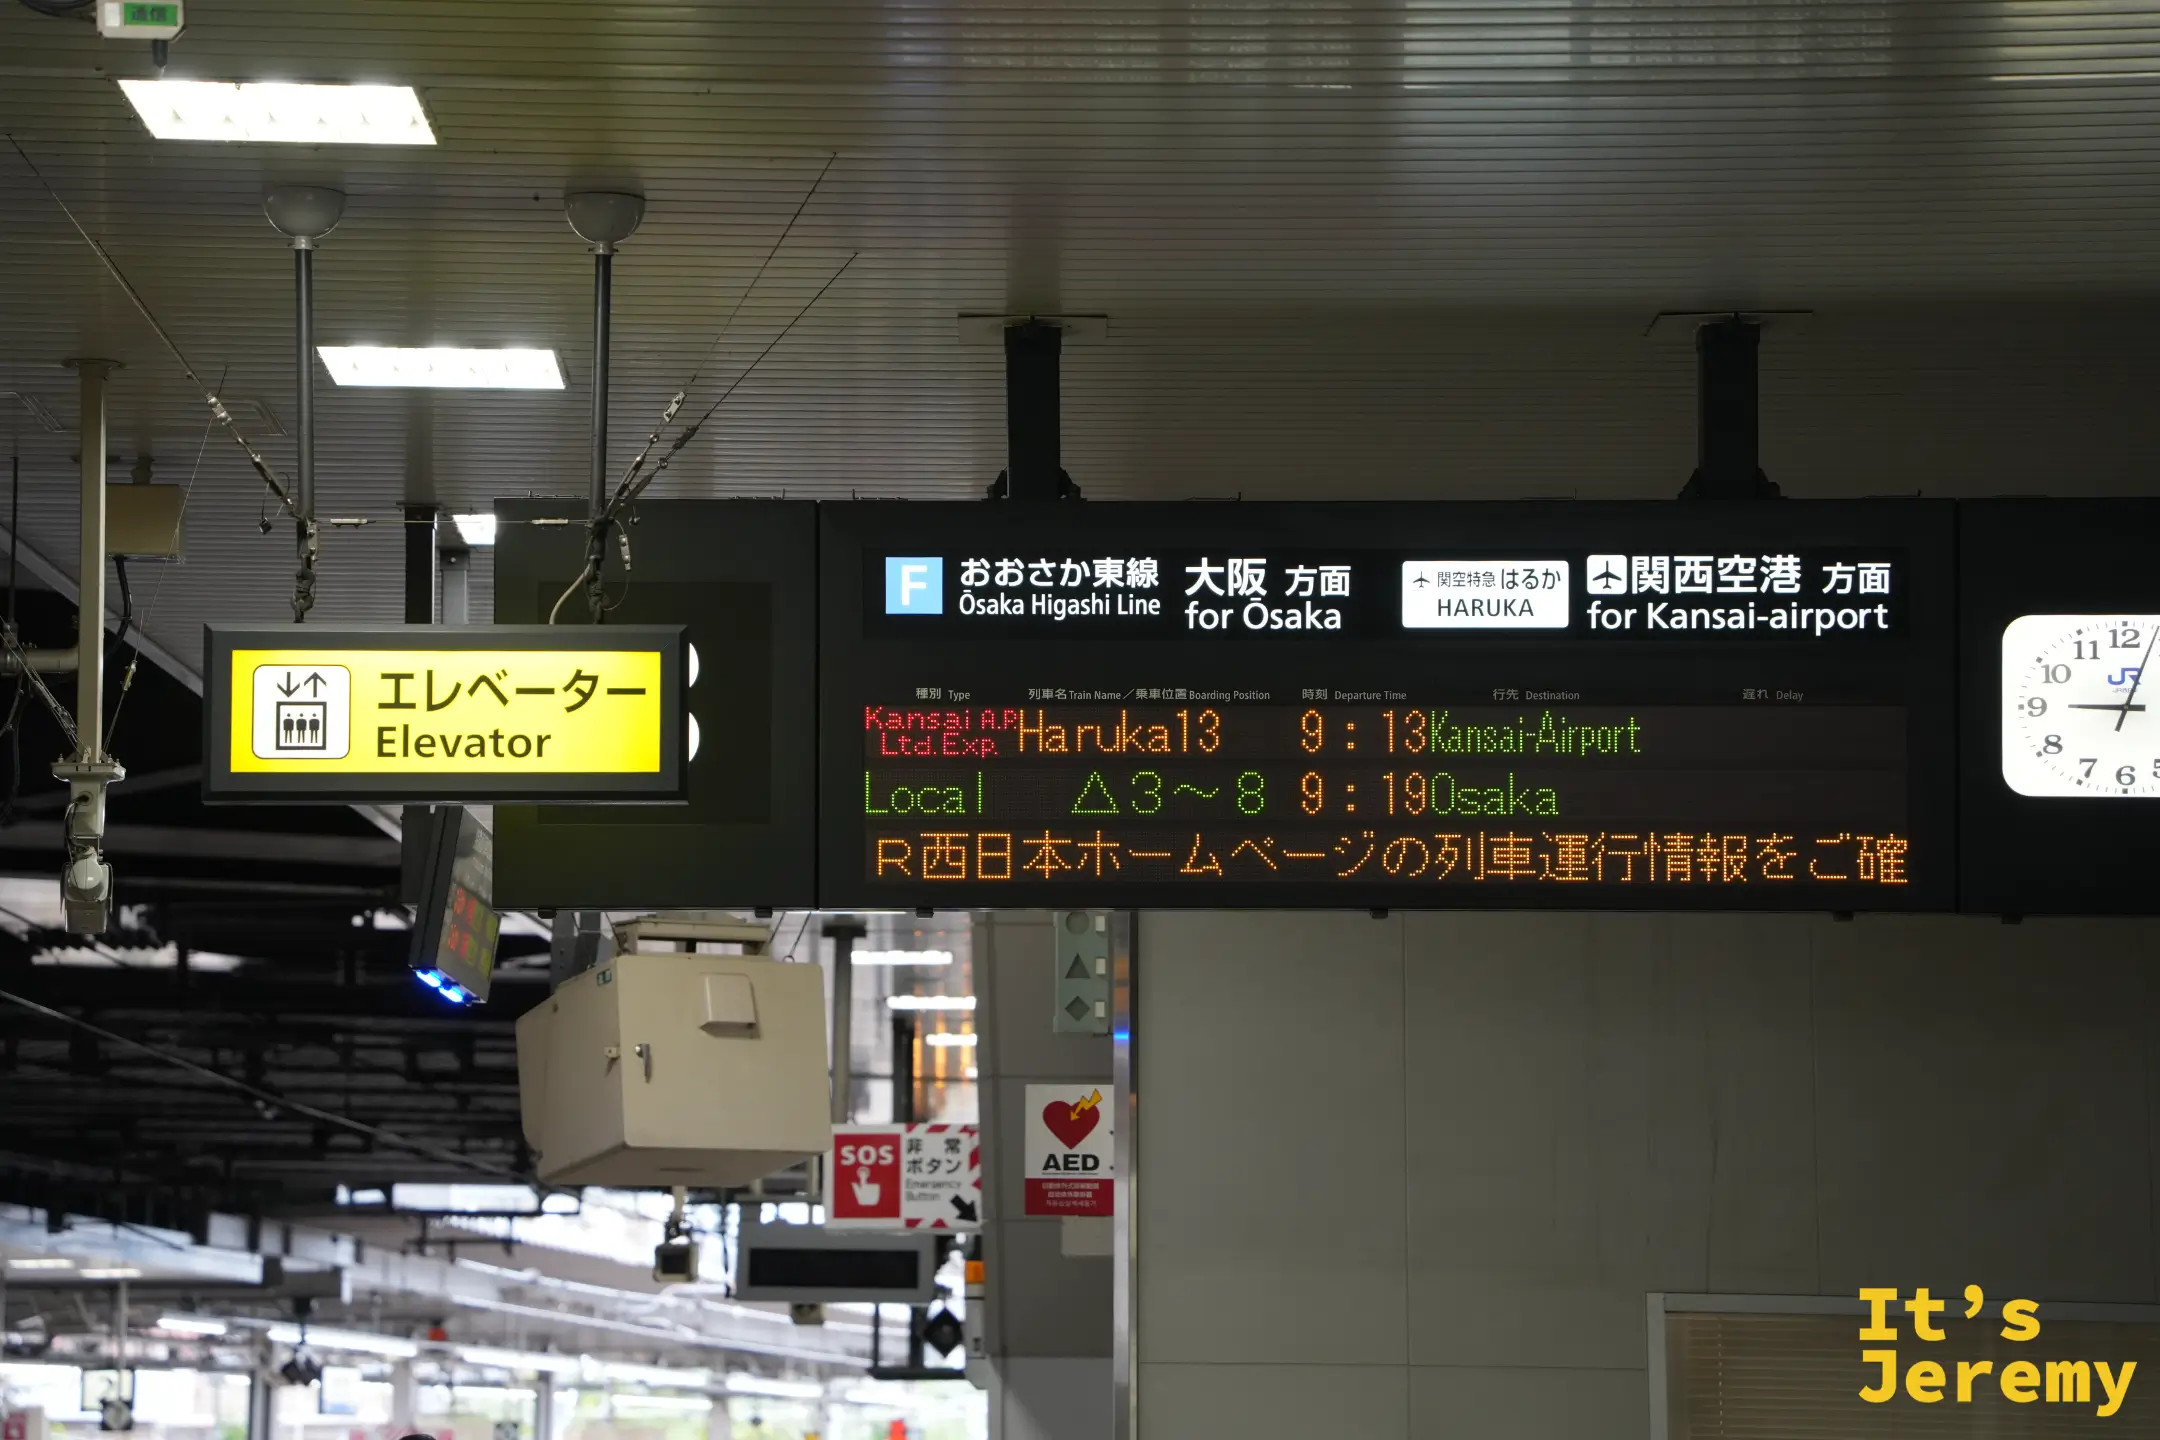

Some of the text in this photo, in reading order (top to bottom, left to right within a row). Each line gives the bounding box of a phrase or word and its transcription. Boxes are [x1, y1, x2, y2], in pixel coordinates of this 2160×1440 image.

[960, 556, 1159, 589] おおさか東線
[1184, 556, 1352, 597] 大阪 方面
[1437, 567, 1561, 590] 関空特急 はるか
[1631, 554, 1891, 595] 関西空港 方面
[901, 565, 927, 606] F
[959, 589, 1161, 621] Ōsaka Higashi Line
[1184, 597, 1341, 630] for Ōsaka
[1437, 598, 1535, 617] HARUKA
[1586, 600, 1889, 637] for Kansai-airport
[2108, 628, 2141, 649] 12
[2073, 640, 2101, 660] 11
[2041, 663, 2072, 684] 10
[378, 669, 646, 713] エレベーター
[915, 687, 971, 702] 種別 Type
[1094, 690, 1122, 700] Name
[1233, 690, 1270, 700] Position
[1302, 688, 1407, 703] 時刻 Departure Time
[1492, 688, 1580, 701] 行先 Destination
[1742, 688, 1804, 702] 遅れ Delay
[2027, 696, 2048, 718] 9
[865, 706, 969, 730] Kansai
[377, 723, 551, 758] Elevator
[1431, 710, 1641, 756] Kansai-Airport
[2042, 734, 2064, 755] 8
[2079, 758, 2098, 779] 7
[2115, 765, 2136, 786] 6
[865, 771, 982, 813] Local
[1431, 772, 1559, 815] Osaka
[841, 1145, 893, 1165] SOS
[907, 1157, 961, 1174] ボタン
[1042, 1154, 1100, 1171] AED
